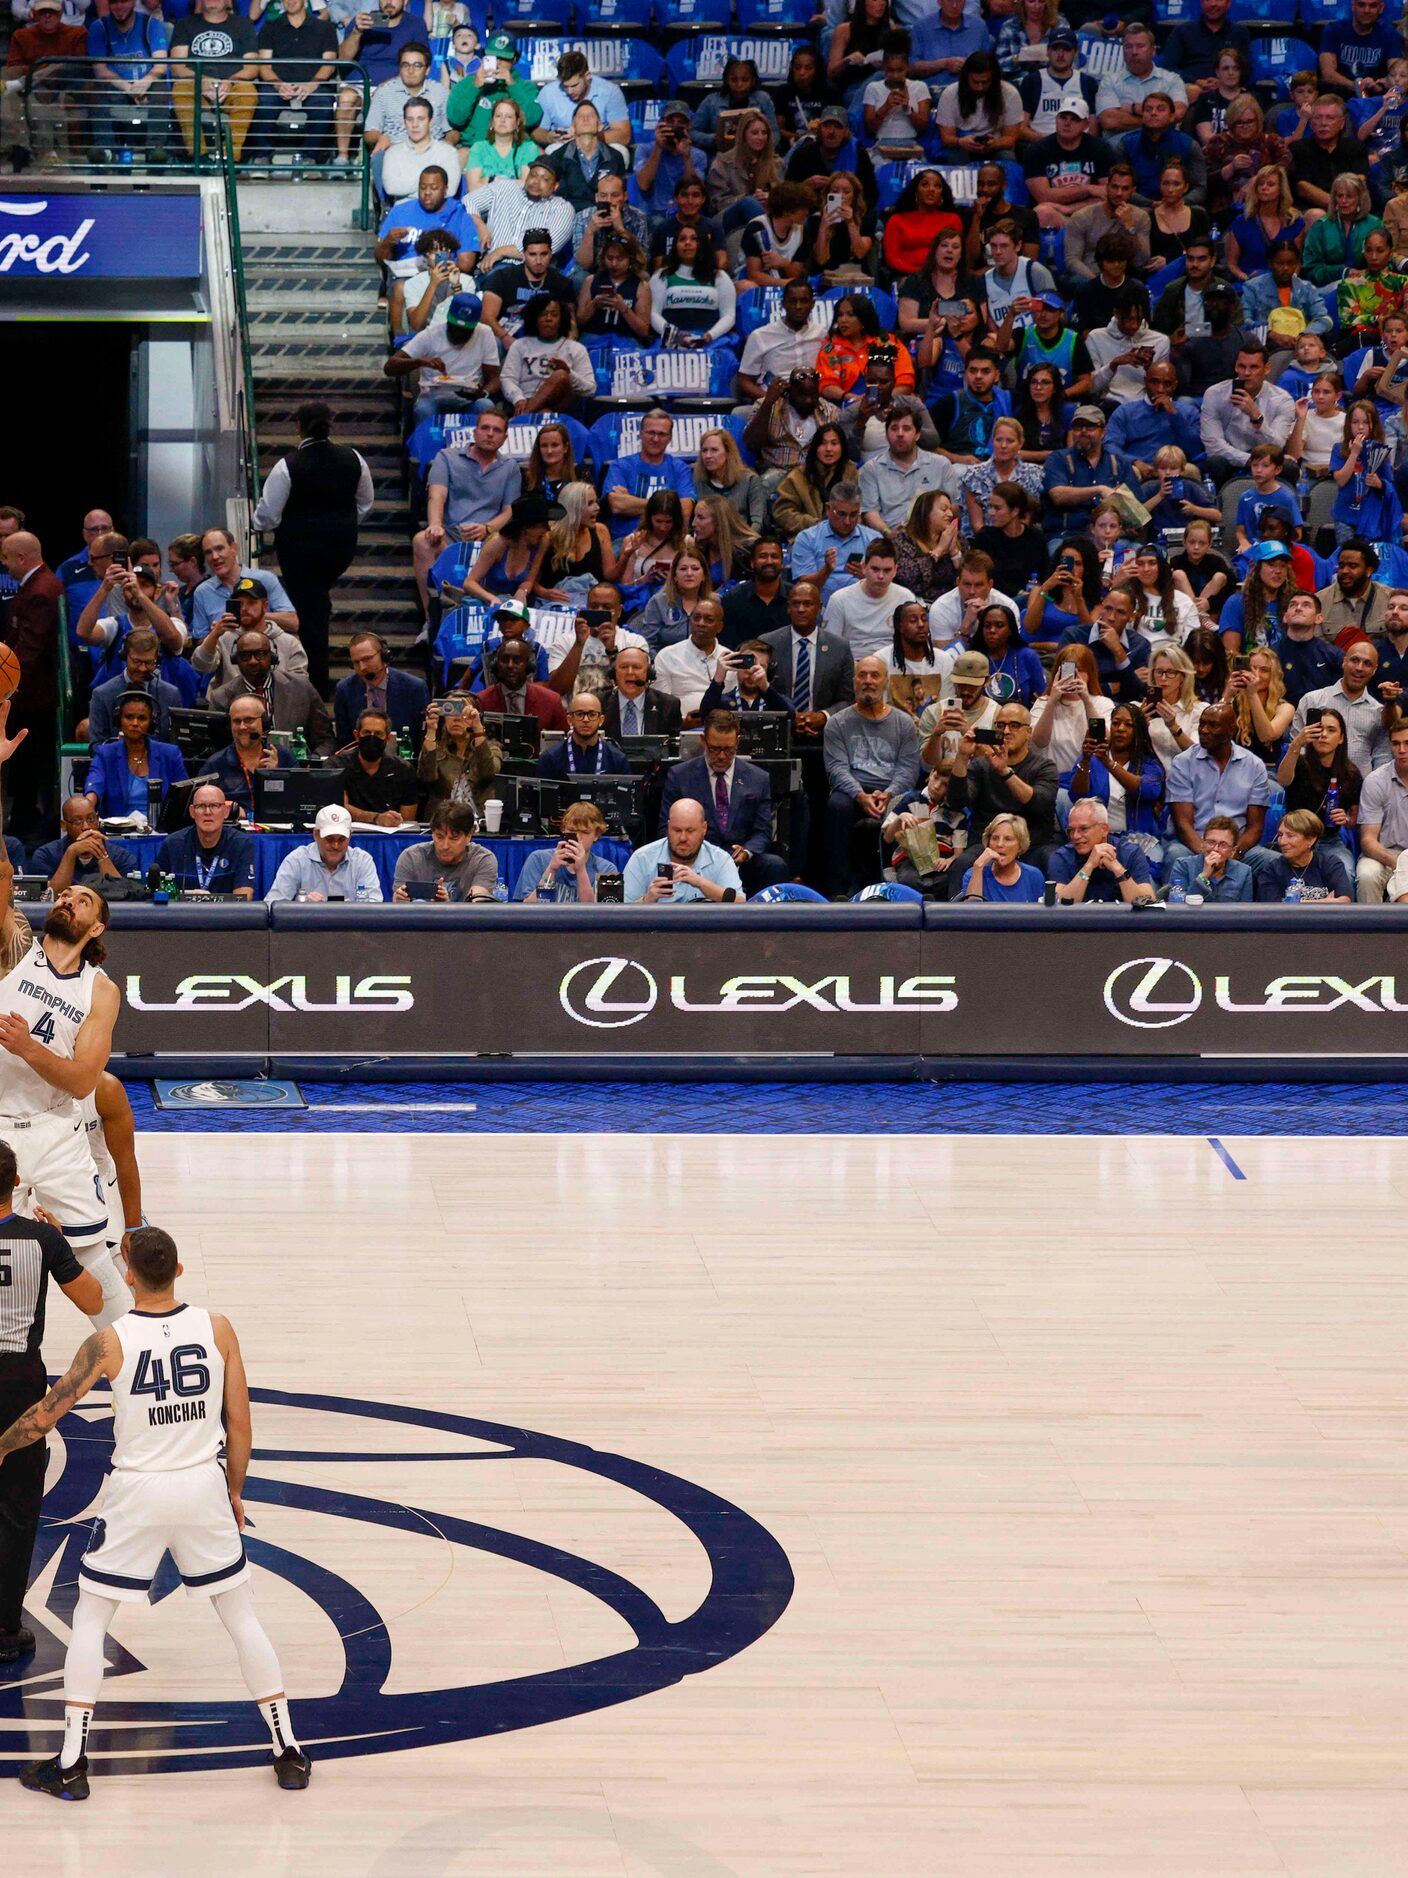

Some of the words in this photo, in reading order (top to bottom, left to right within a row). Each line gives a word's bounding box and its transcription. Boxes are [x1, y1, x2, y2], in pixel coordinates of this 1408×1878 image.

[615, 352, 640, 369] LET'S
[649, 352, 710, 390] LOUD!
[17, 979, 85, 1025] MEMPHIS
[126, 974, 415, 1012] LEXUS
[670, 974, 959, 1012] LEXUS
[30, 1011, 55, 1045] 4
[130, 1343, 211, 1402] 46
[148, 1400, 207, 1427] KONCHAR
